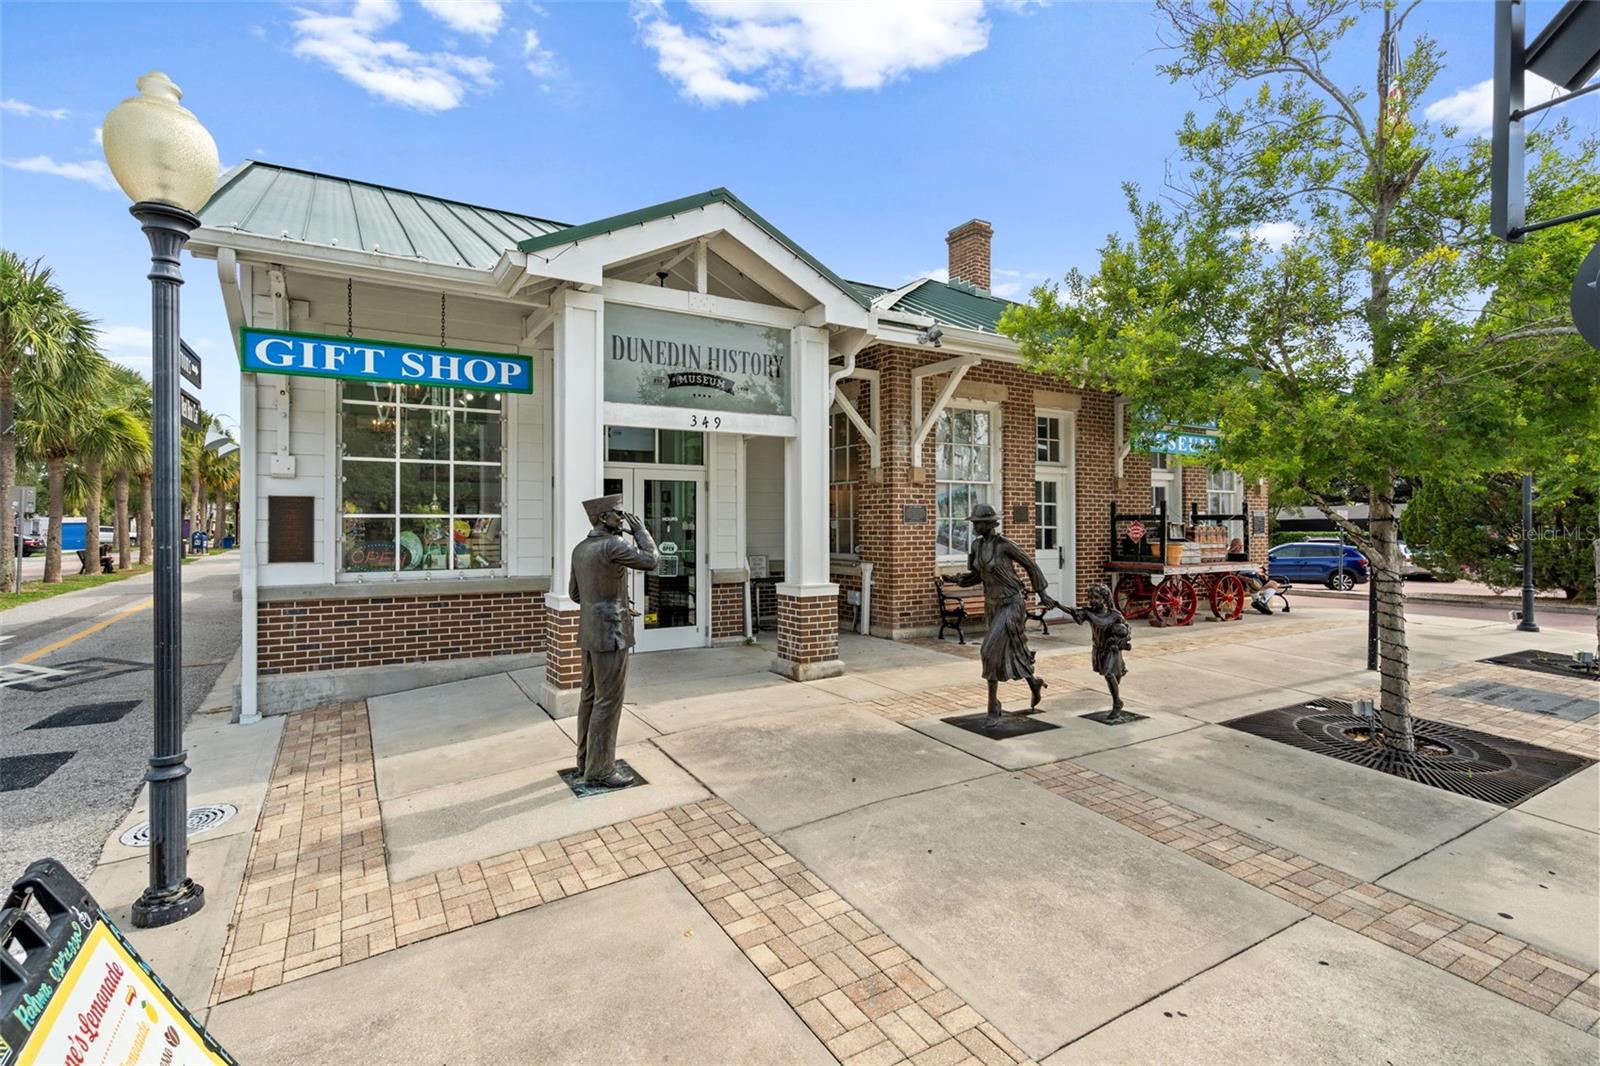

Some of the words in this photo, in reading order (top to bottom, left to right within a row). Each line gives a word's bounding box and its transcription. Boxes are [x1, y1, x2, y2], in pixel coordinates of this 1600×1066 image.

[254, 337, 385, 375] GIFT
[400, 351, 522, 386] SHOP
[611, 334, 702, 370] DUNEDIN
[707, 346, 785, 379] HISTORY
[679, 374, 726, 389] MUSEUM
[689, 414, 722, 430] 349
[1139, 430, 1218, 454] USEU
[79, 960, 125, 1043] Lemonade
